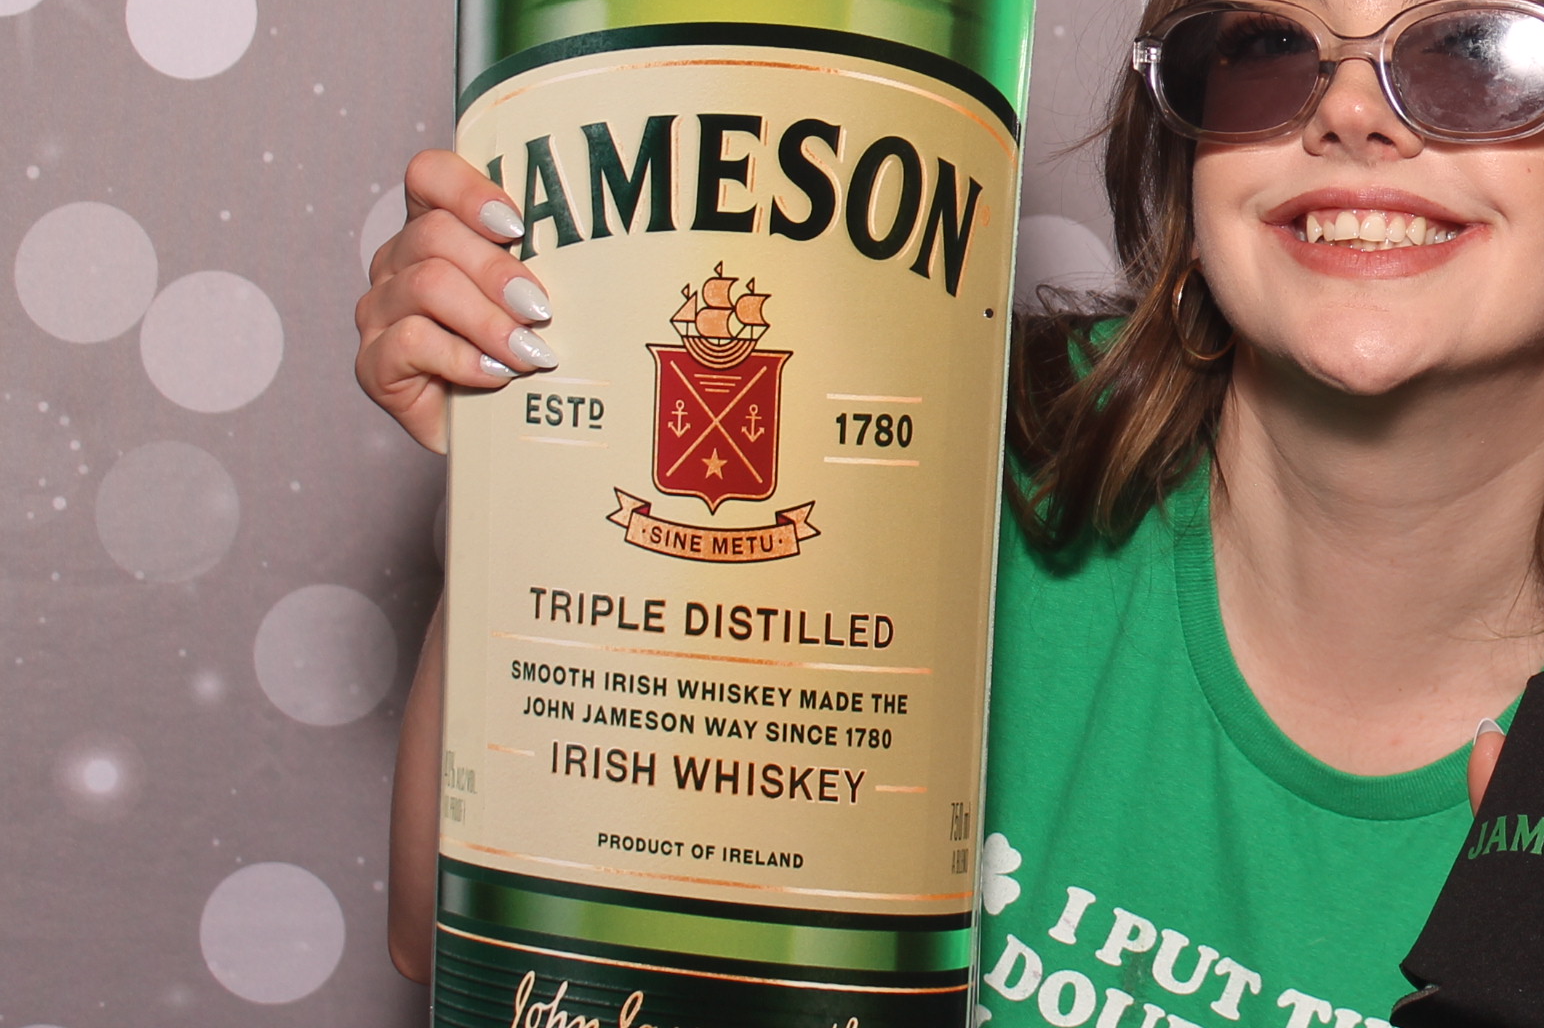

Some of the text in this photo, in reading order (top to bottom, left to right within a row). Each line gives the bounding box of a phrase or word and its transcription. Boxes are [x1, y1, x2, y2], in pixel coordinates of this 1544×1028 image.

[525, 392, 605, 430] ESTD
[834, 412, 915, 449] 1780
[649, 525, 775, 556] SINE METU
[530, 586, 895, 649] TRIPLE DISTILLED
[511, 659, 909, 715] SMOOTH IRISH WHISKEY MADE THE
[523, 695, 893, 749] JOHN JAMESON WAY SINCE 1780
[551, 740, 866, 804] IRISH WHISKEY
[597, 832, 805, 870] PRODUCT OF IRELAND
[983, 933, 1206, 1028] DOU
[1048, 886, 1097, 945] I
[1095, 907, 1262, 1021] PUT
